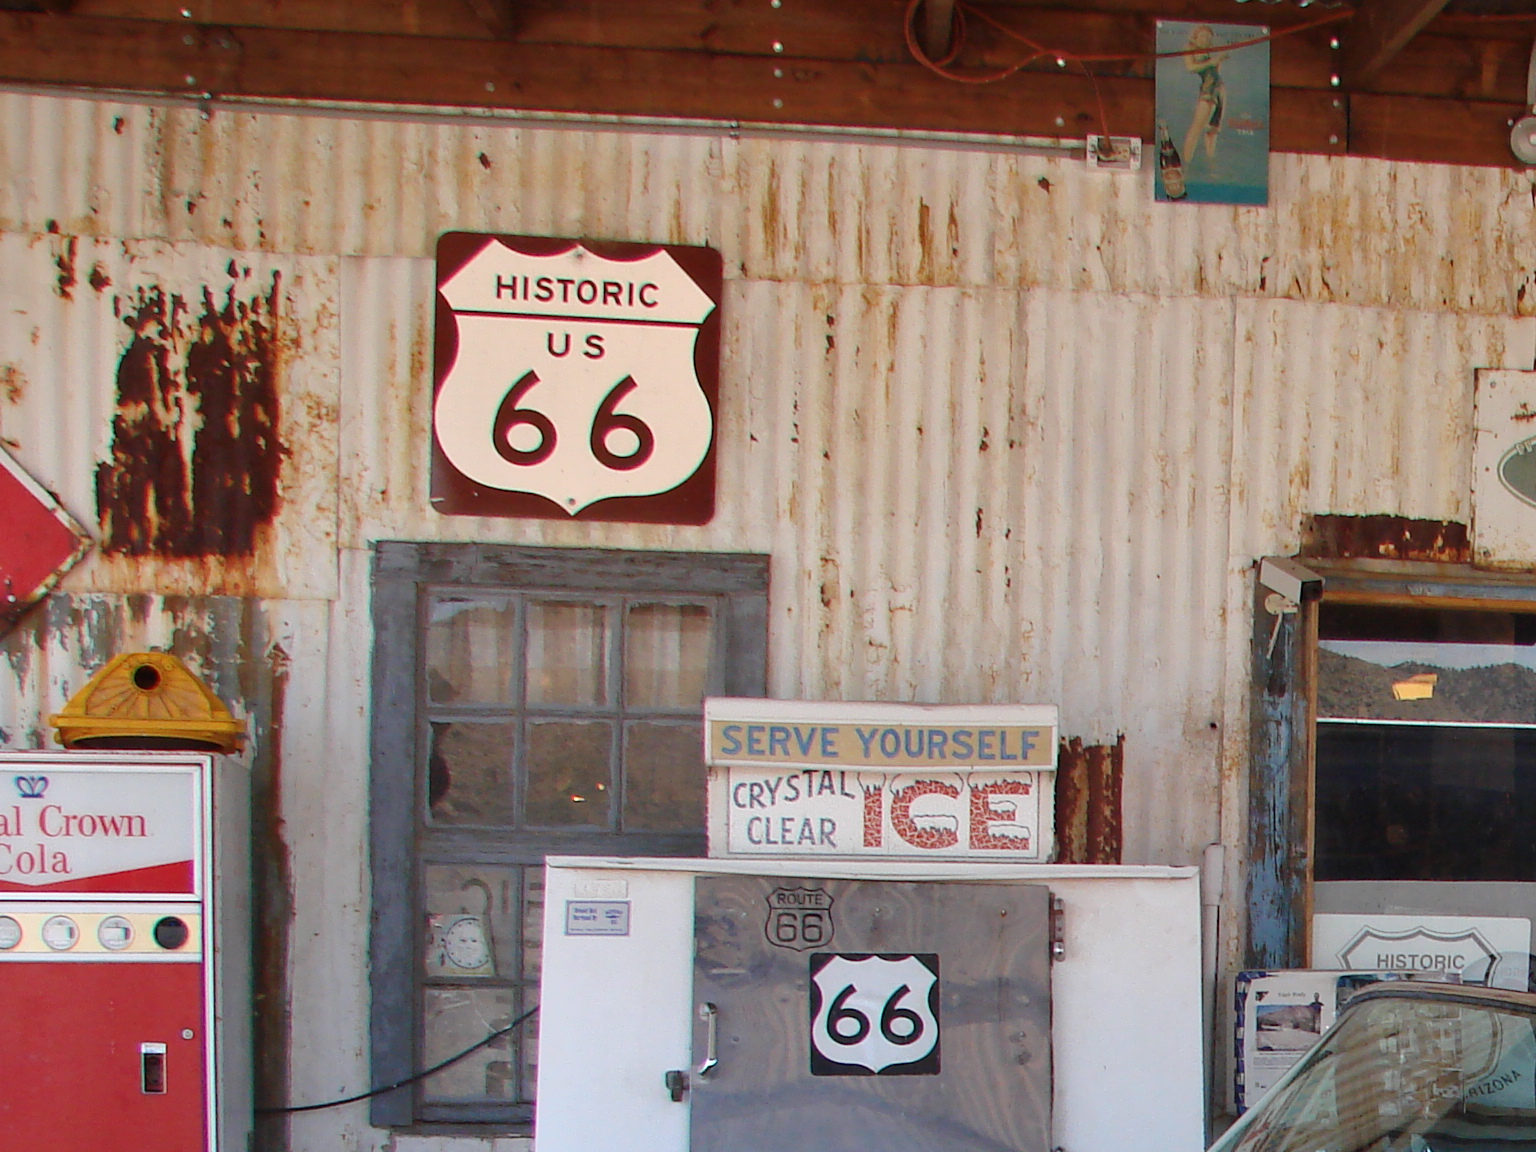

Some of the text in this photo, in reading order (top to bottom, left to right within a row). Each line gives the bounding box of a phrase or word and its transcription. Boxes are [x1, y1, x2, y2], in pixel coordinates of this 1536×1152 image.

[495, 273, 660, 309] HISTORIC
[546, 331, 606, 360] US
[491, 368, 656, 471] 66
[721, 725, 1041, 761] SERVE YOURSELF
[38, 804, 148, 838] Crown
[732, 769, 1034, 851] CRYSTAL ICE
[747, 815, 838, 849] CLEAR
[776, 892, 824, 906] ROUTE
[776, 912, 824, 944] 66
[1376, 954, 1466, 970] HISTORIC
[825, 983, 924, 1047] 66
[1466, 1069, 1522, 1099] RIZONA
